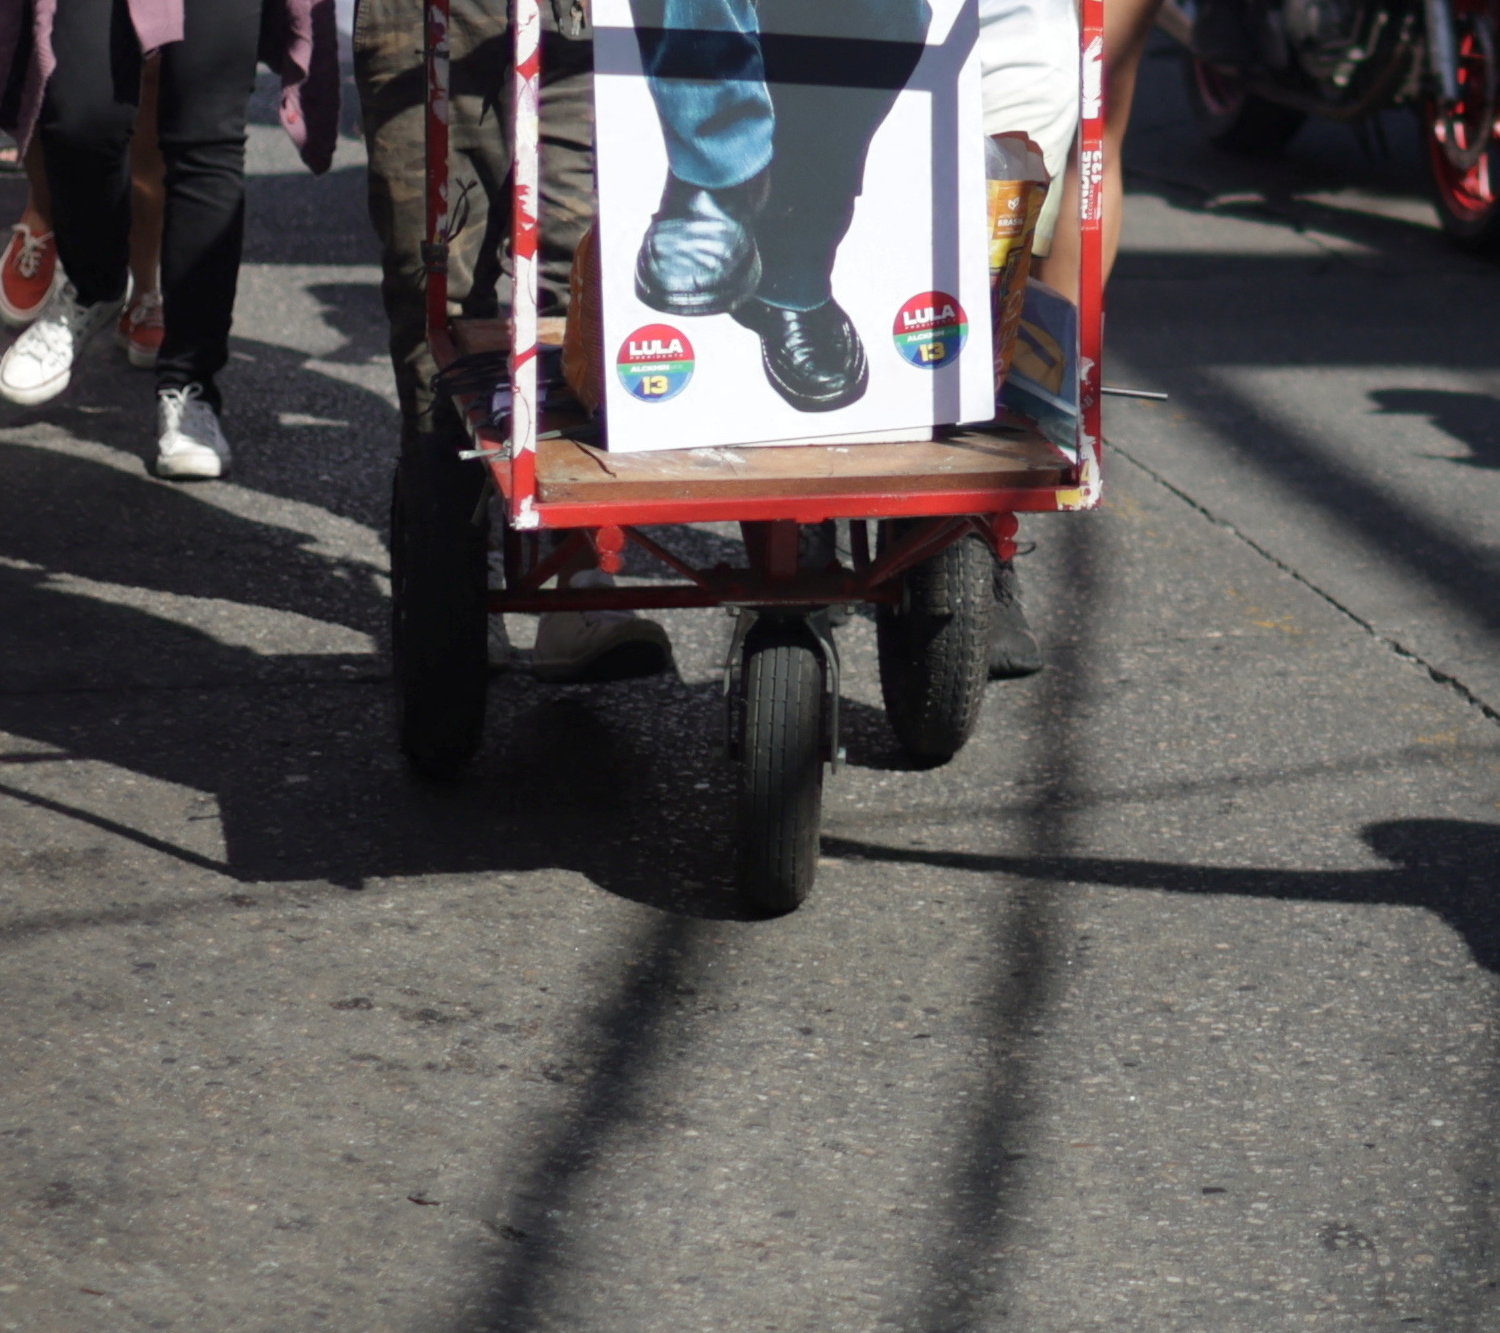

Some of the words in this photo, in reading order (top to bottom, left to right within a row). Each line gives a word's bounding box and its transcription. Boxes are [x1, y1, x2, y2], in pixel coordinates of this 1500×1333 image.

[902, 304, 956, 326] LULA
[629, 338, 684, 355] LULA
[919, 341, 946, 362] 13
[630, 364, 670, 373] ALCKMIN
[642, 375, 669, 395] 13
